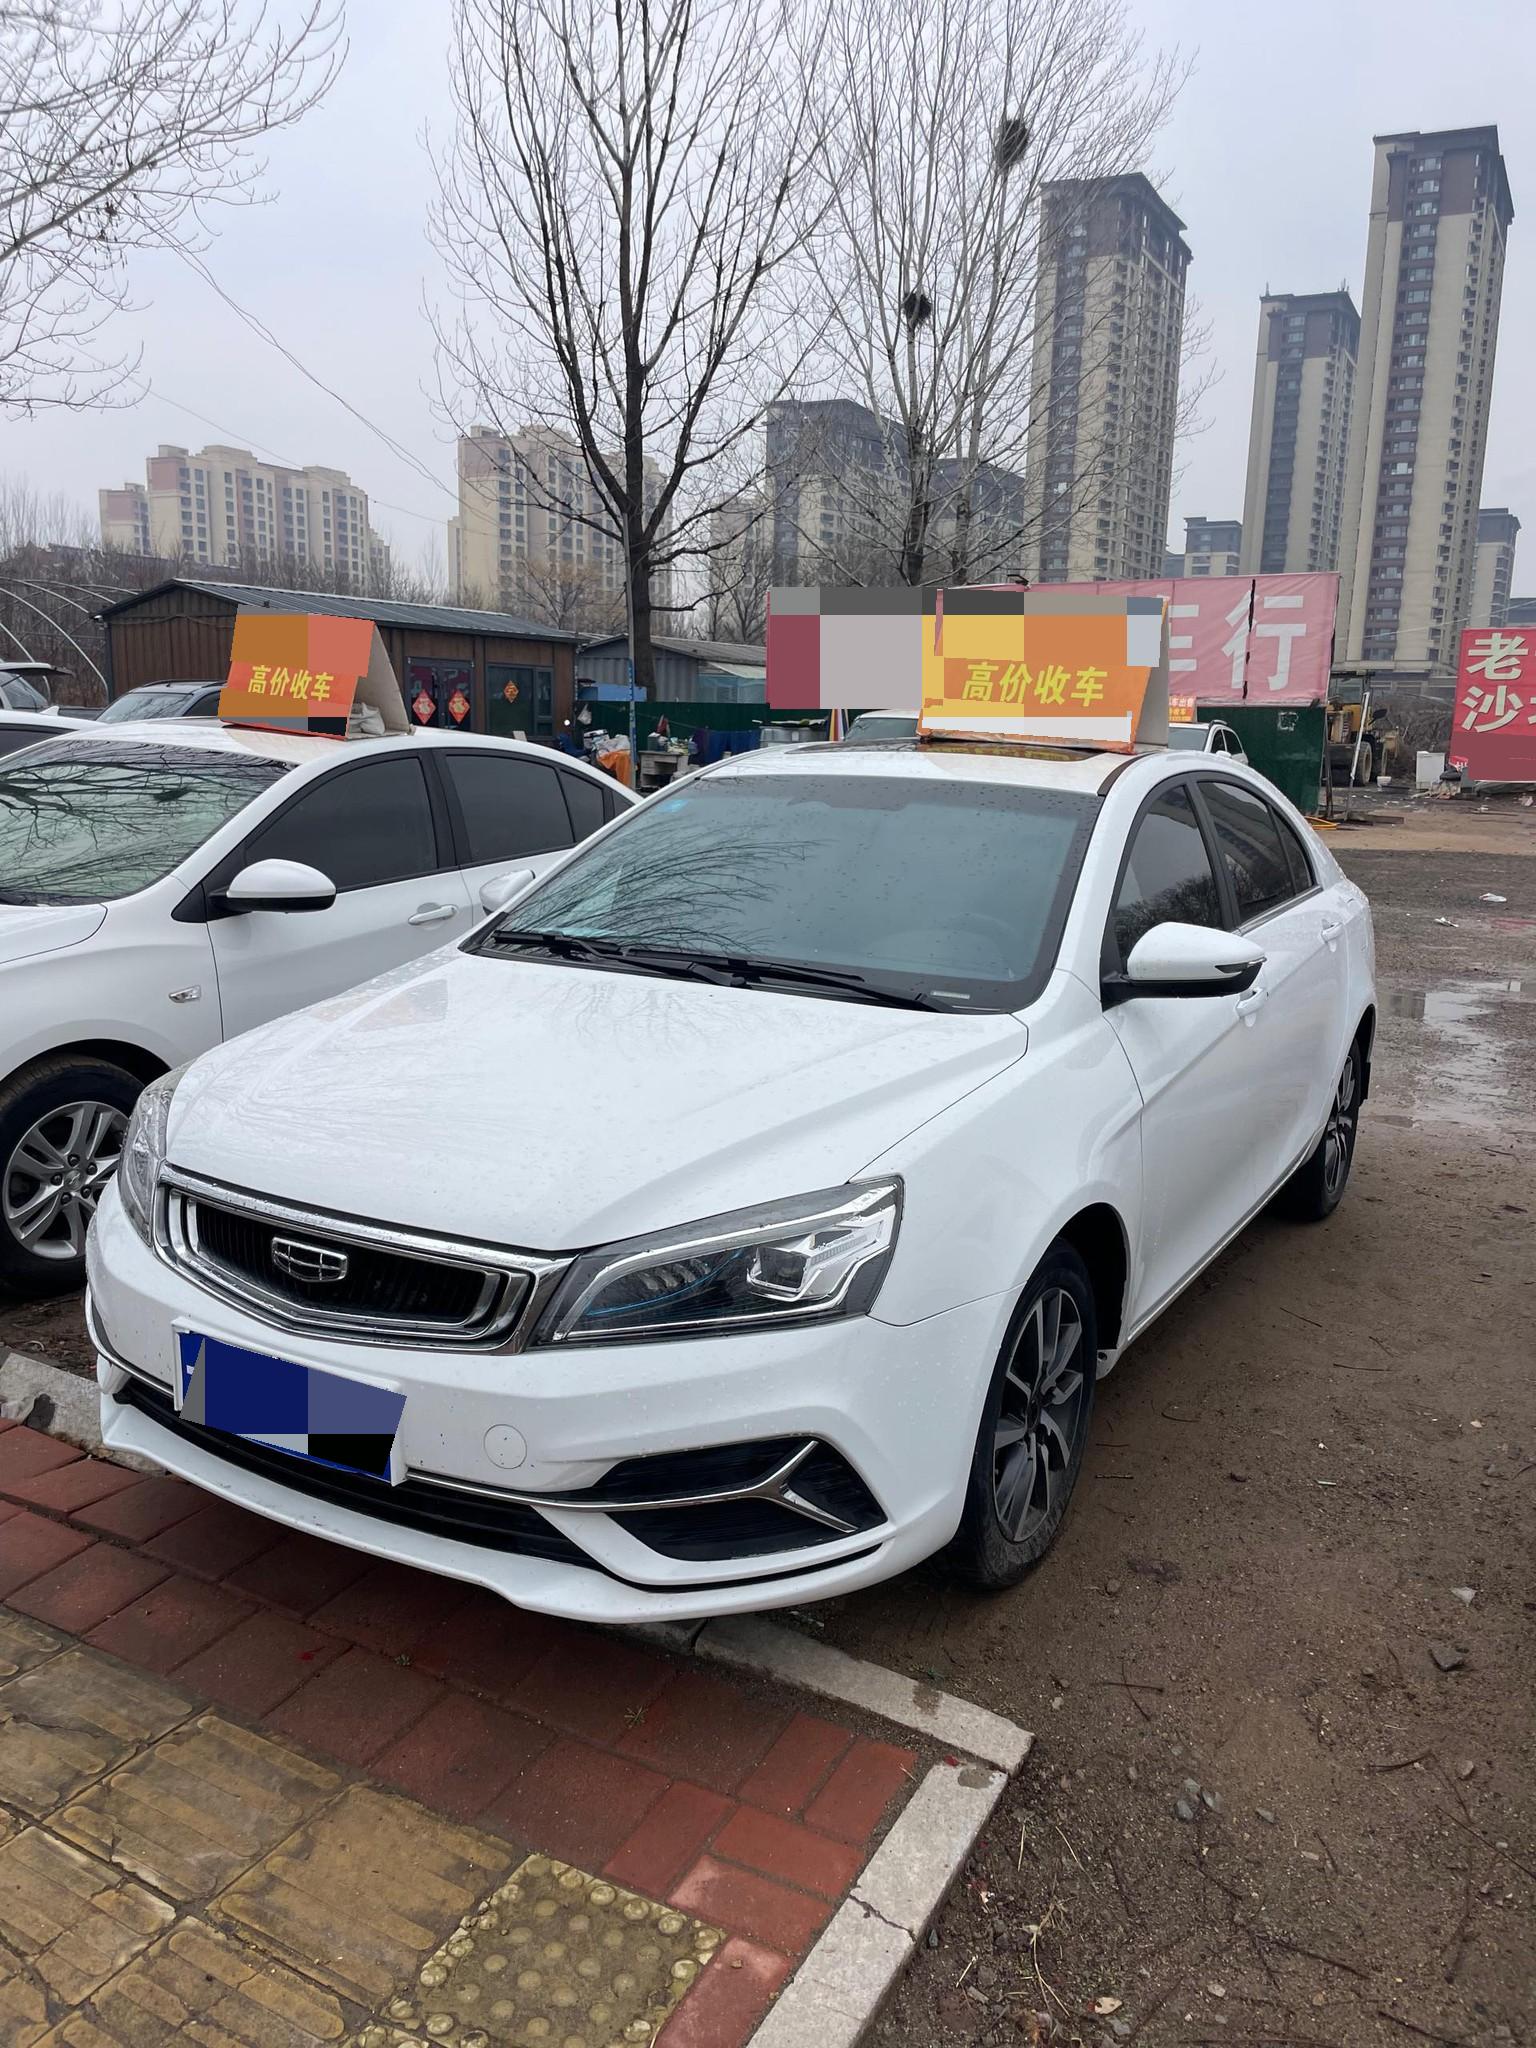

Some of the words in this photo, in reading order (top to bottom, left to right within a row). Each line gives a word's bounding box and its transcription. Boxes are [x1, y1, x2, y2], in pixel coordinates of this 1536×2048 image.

[1465, 632, 1536, 680] 老
[247, 665, 334, 702] 高价收车
[962, 661, 1108, 707] 高价收车
[1461, 685, 1536, 733] 沙
